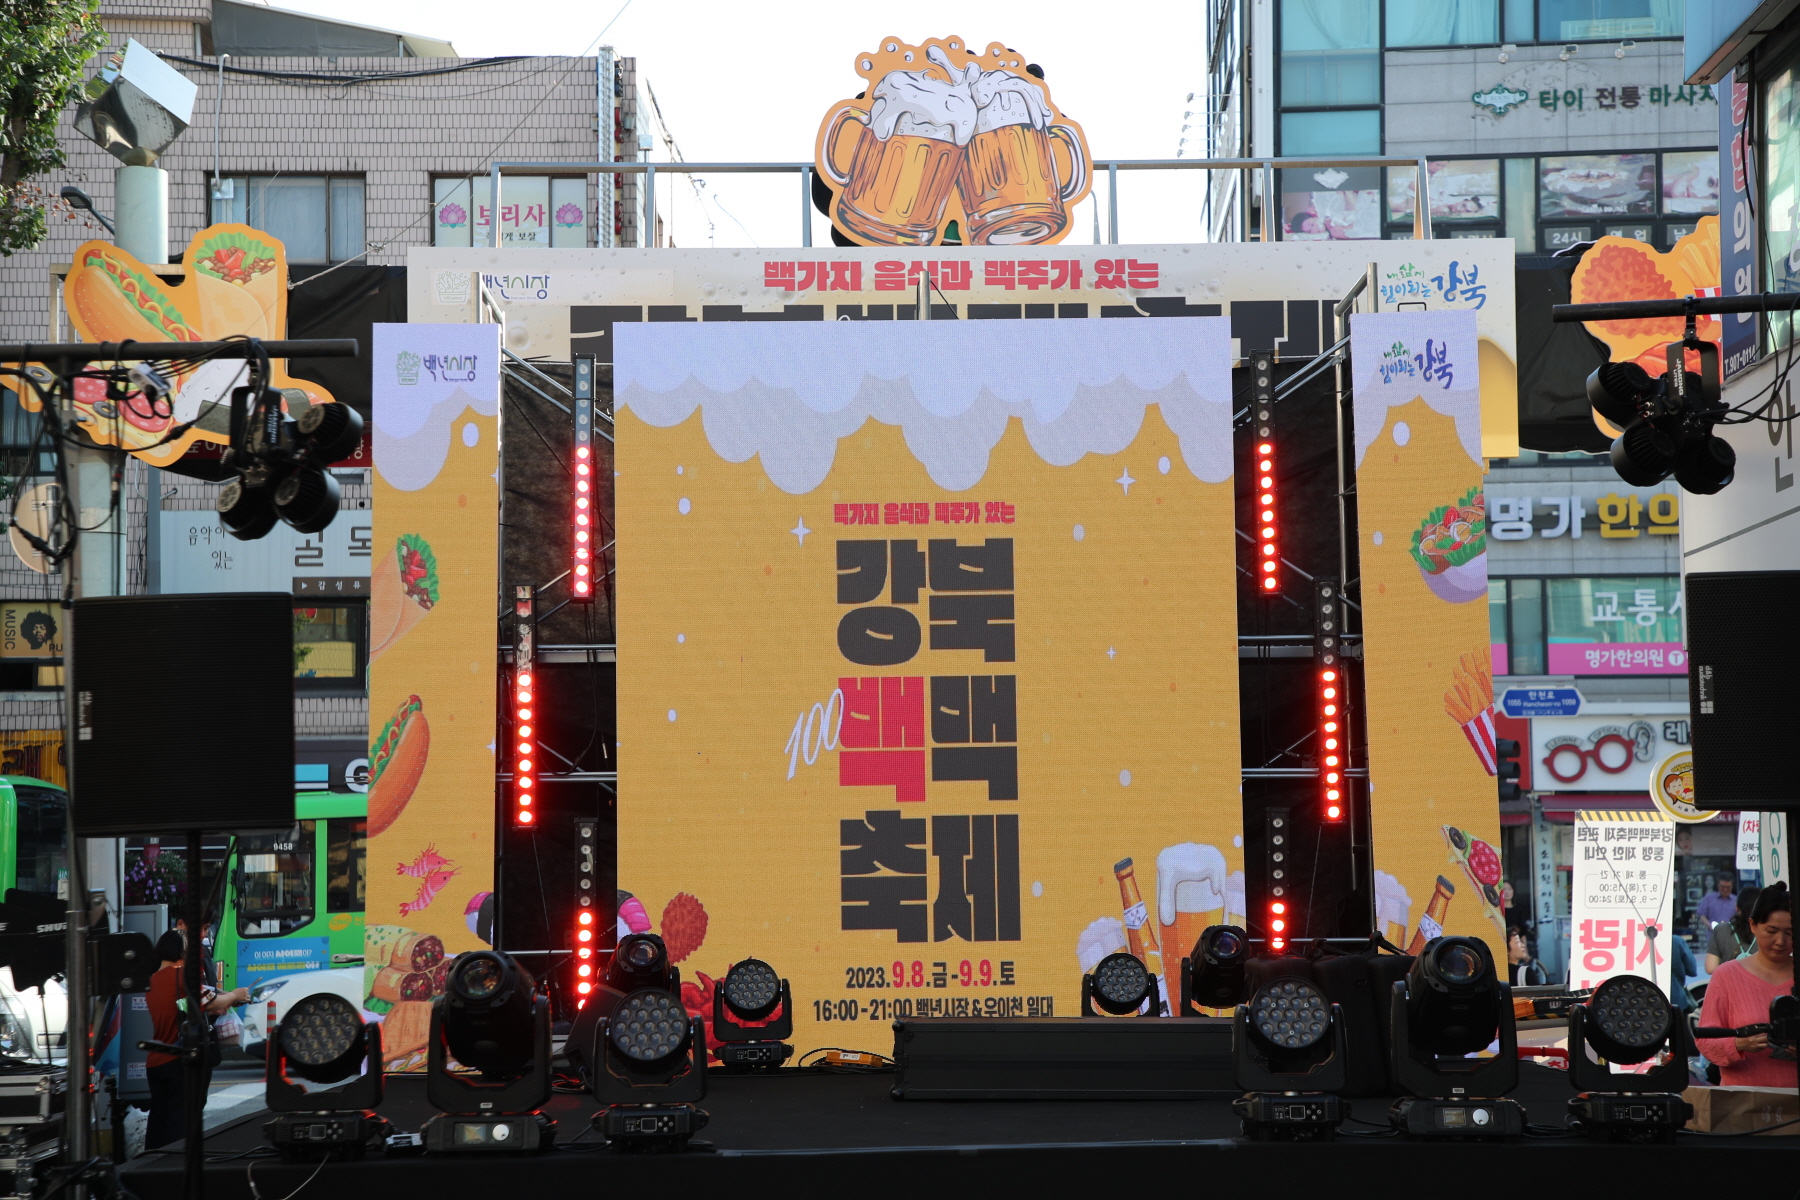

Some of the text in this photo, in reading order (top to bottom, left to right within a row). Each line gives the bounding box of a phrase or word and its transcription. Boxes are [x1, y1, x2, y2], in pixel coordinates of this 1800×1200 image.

[1539, 88, 1583, 111] 타이
[1596, 86, 1641, 109] 전통
[1553, 232, 1582, 245] 24시
[764, 258, 1158, 291] 백가지 음식과 맥주가 있는
[1431, 261, 1486, 310] 강북
[1415, 339, 1453, 390] 강북
[834, 502, 1015, 525] 백가지 음식과 맥주가 있는
[1490, 495, 1586, 540] 명가
[212, 551, 233, 570] 있는
[836, 538, 1016, 666] 강북
[4, 609, 16, 650] MUSIC
[49, 644, 63, 652] PU
[1585, 649, 1664, 668] 명가한의원
[784, 688, 844, 780] 100
[838, 675, 1018, 802] 백맥
[273, 843, 293, 851] 9458
[840, 810, 1021, 943] 축제
[1027, 996, 1053, 1017] 일대
